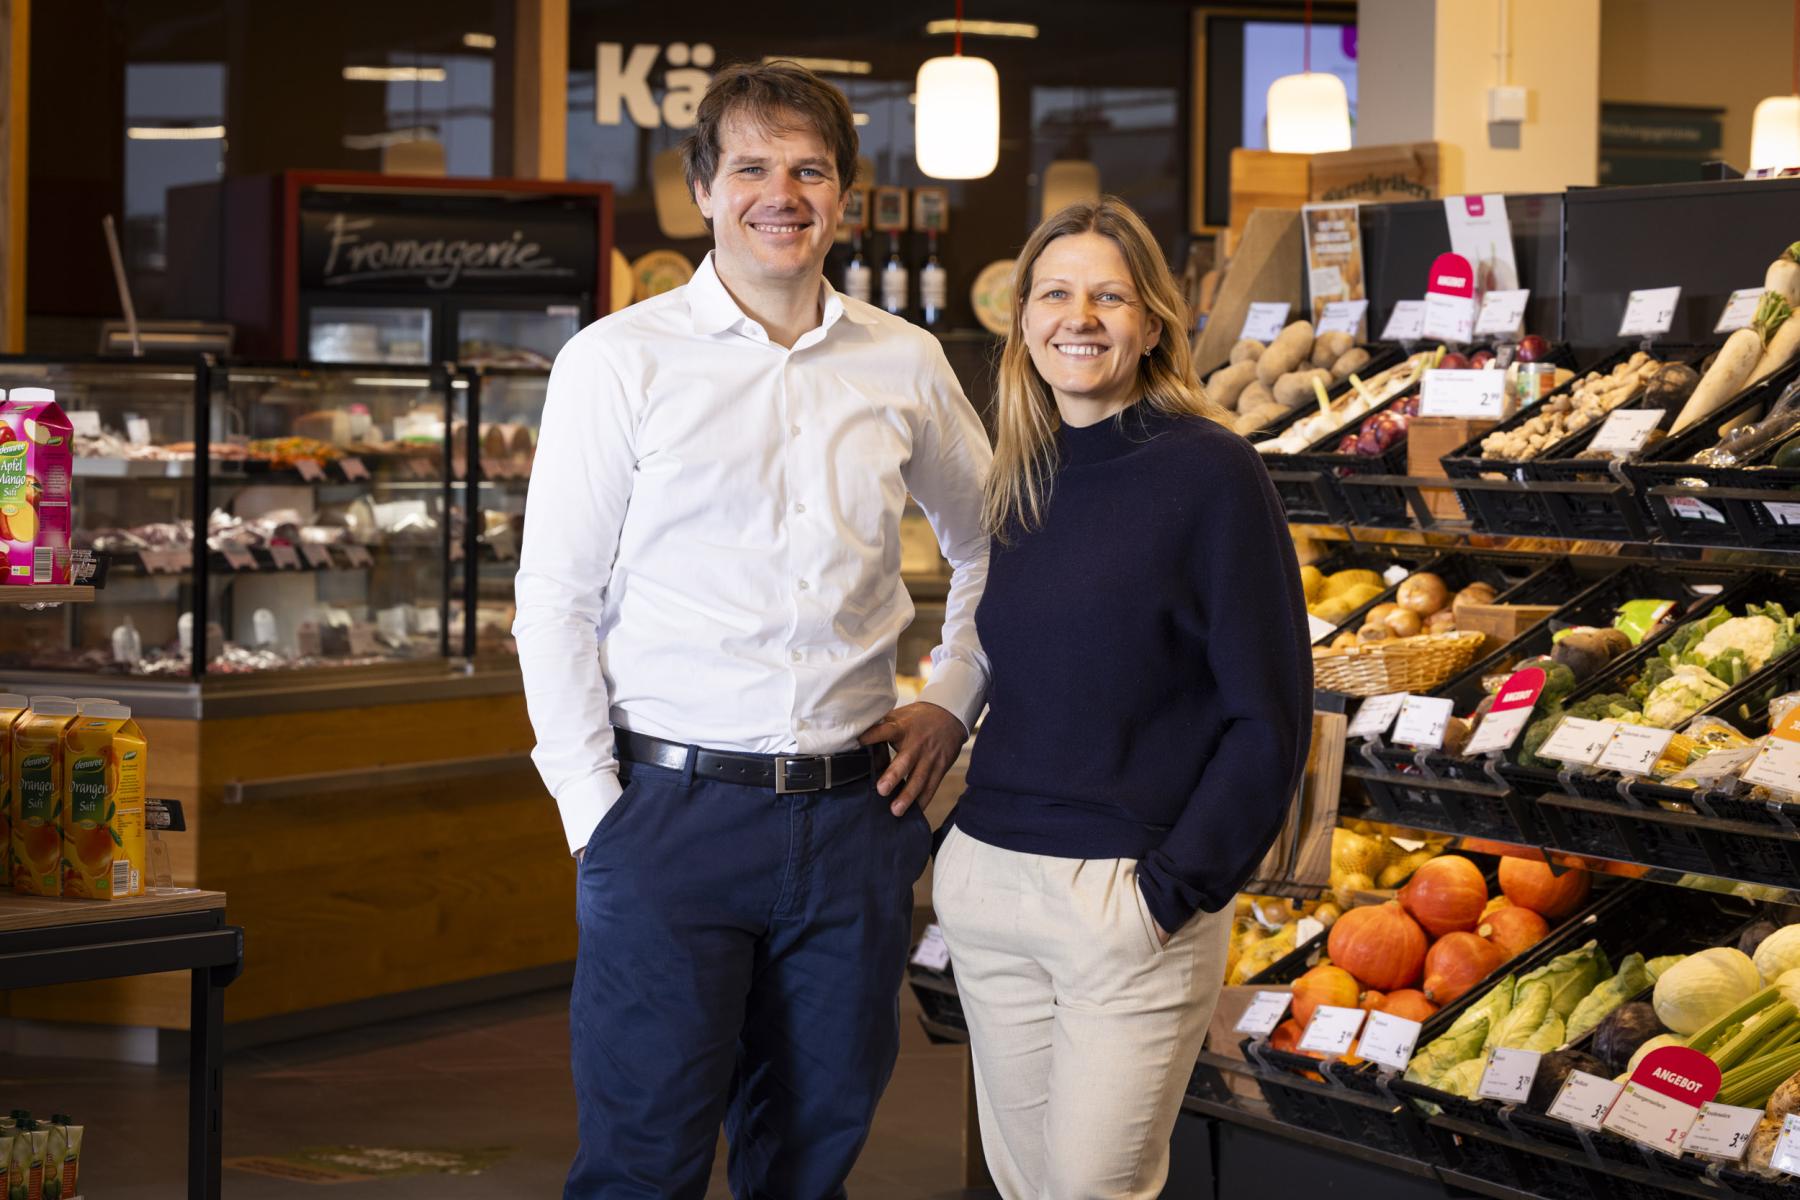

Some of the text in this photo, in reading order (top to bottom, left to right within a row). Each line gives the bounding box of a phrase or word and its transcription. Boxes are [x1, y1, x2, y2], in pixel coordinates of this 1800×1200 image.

[325, 213, 553, 288] Fromagerie
[1, 457, 22, 474] Apfel
[75, 759, 103, 770] dennree
[69, 781, 108, 800] Orangen
[28, 798, 43, 809] Saft
[80, 801, 96, 812] Saft
[1652, 1067, 1704, 1094] ANGEBOT
[1665, 1127, 1687, 1144] 1.9
